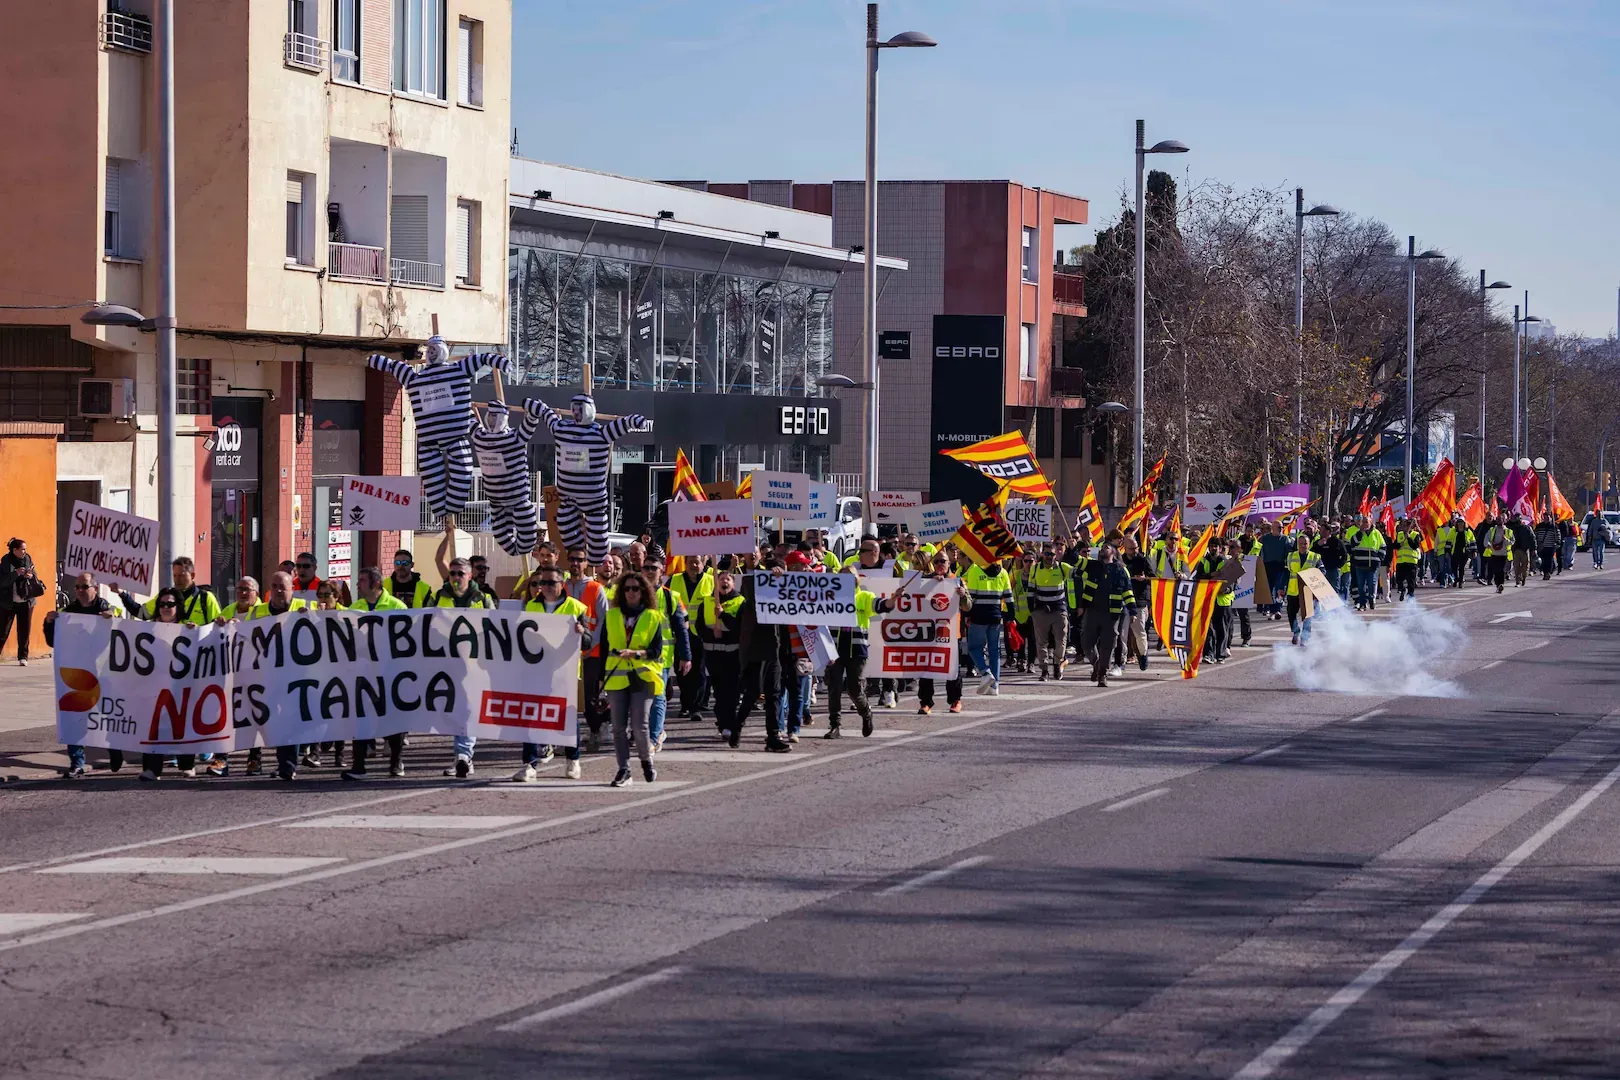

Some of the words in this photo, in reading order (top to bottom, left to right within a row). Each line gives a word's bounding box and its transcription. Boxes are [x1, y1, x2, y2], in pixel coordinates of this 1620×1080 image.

[936, 346, 999, 358] EBRO
[782, 406, 829, 435] EBRO
[216, 424, 241, 452] XCD
[215, 453, 227, 466] rent
[228, 456, 232, 466] a
[232, 455, 242, 466] car
[768, 480, 792, 489] VOLEM
[349, 480, 411, 506] PIRATAS
[768, 491, 793, 500] SEGUIR
[760, 500, 802, 511] TREBALLANT
[695, 515, 711, 524] NO
[715, 514, 730, 523] AL
[922, 510, 946, 518] VOLEM
[74, 508, 89, 536] SI
[88, 514, 111, 542] HAY
[110, 520, 151, 552] OPCIÓN
[918, 525, 959, 537] TREBALLANT
[923, 518, 949, 528] SEGUIR
[676, 526, 749, 538] TANCAMENT
[68, 544, 92, 570] HAY
[92, 549, 149, 586] OBLIGACIÓN
[756, 573, 842, 591] DEJADNOS
[778, 588, 835, 602] SEGUIR
[758, 602, 856, 615] TRABAJANDO
[885, 622, 932, 640] CGT
[109, 629, 155, 676] DS
[169, 633, 245, 680] Smith
[252, 614, 544, 670] MONTBLANC
[887, 651, 946, 667] CCOO
[101, 697, 125, 716] DS
[148, 684, 228, 741] NO
[232, 684, 271, 729] ES
[287, 671, 455, 721] TANCA
[485, 698, 560, 723] CCOO
[87, 712, 137, 735] Smith
